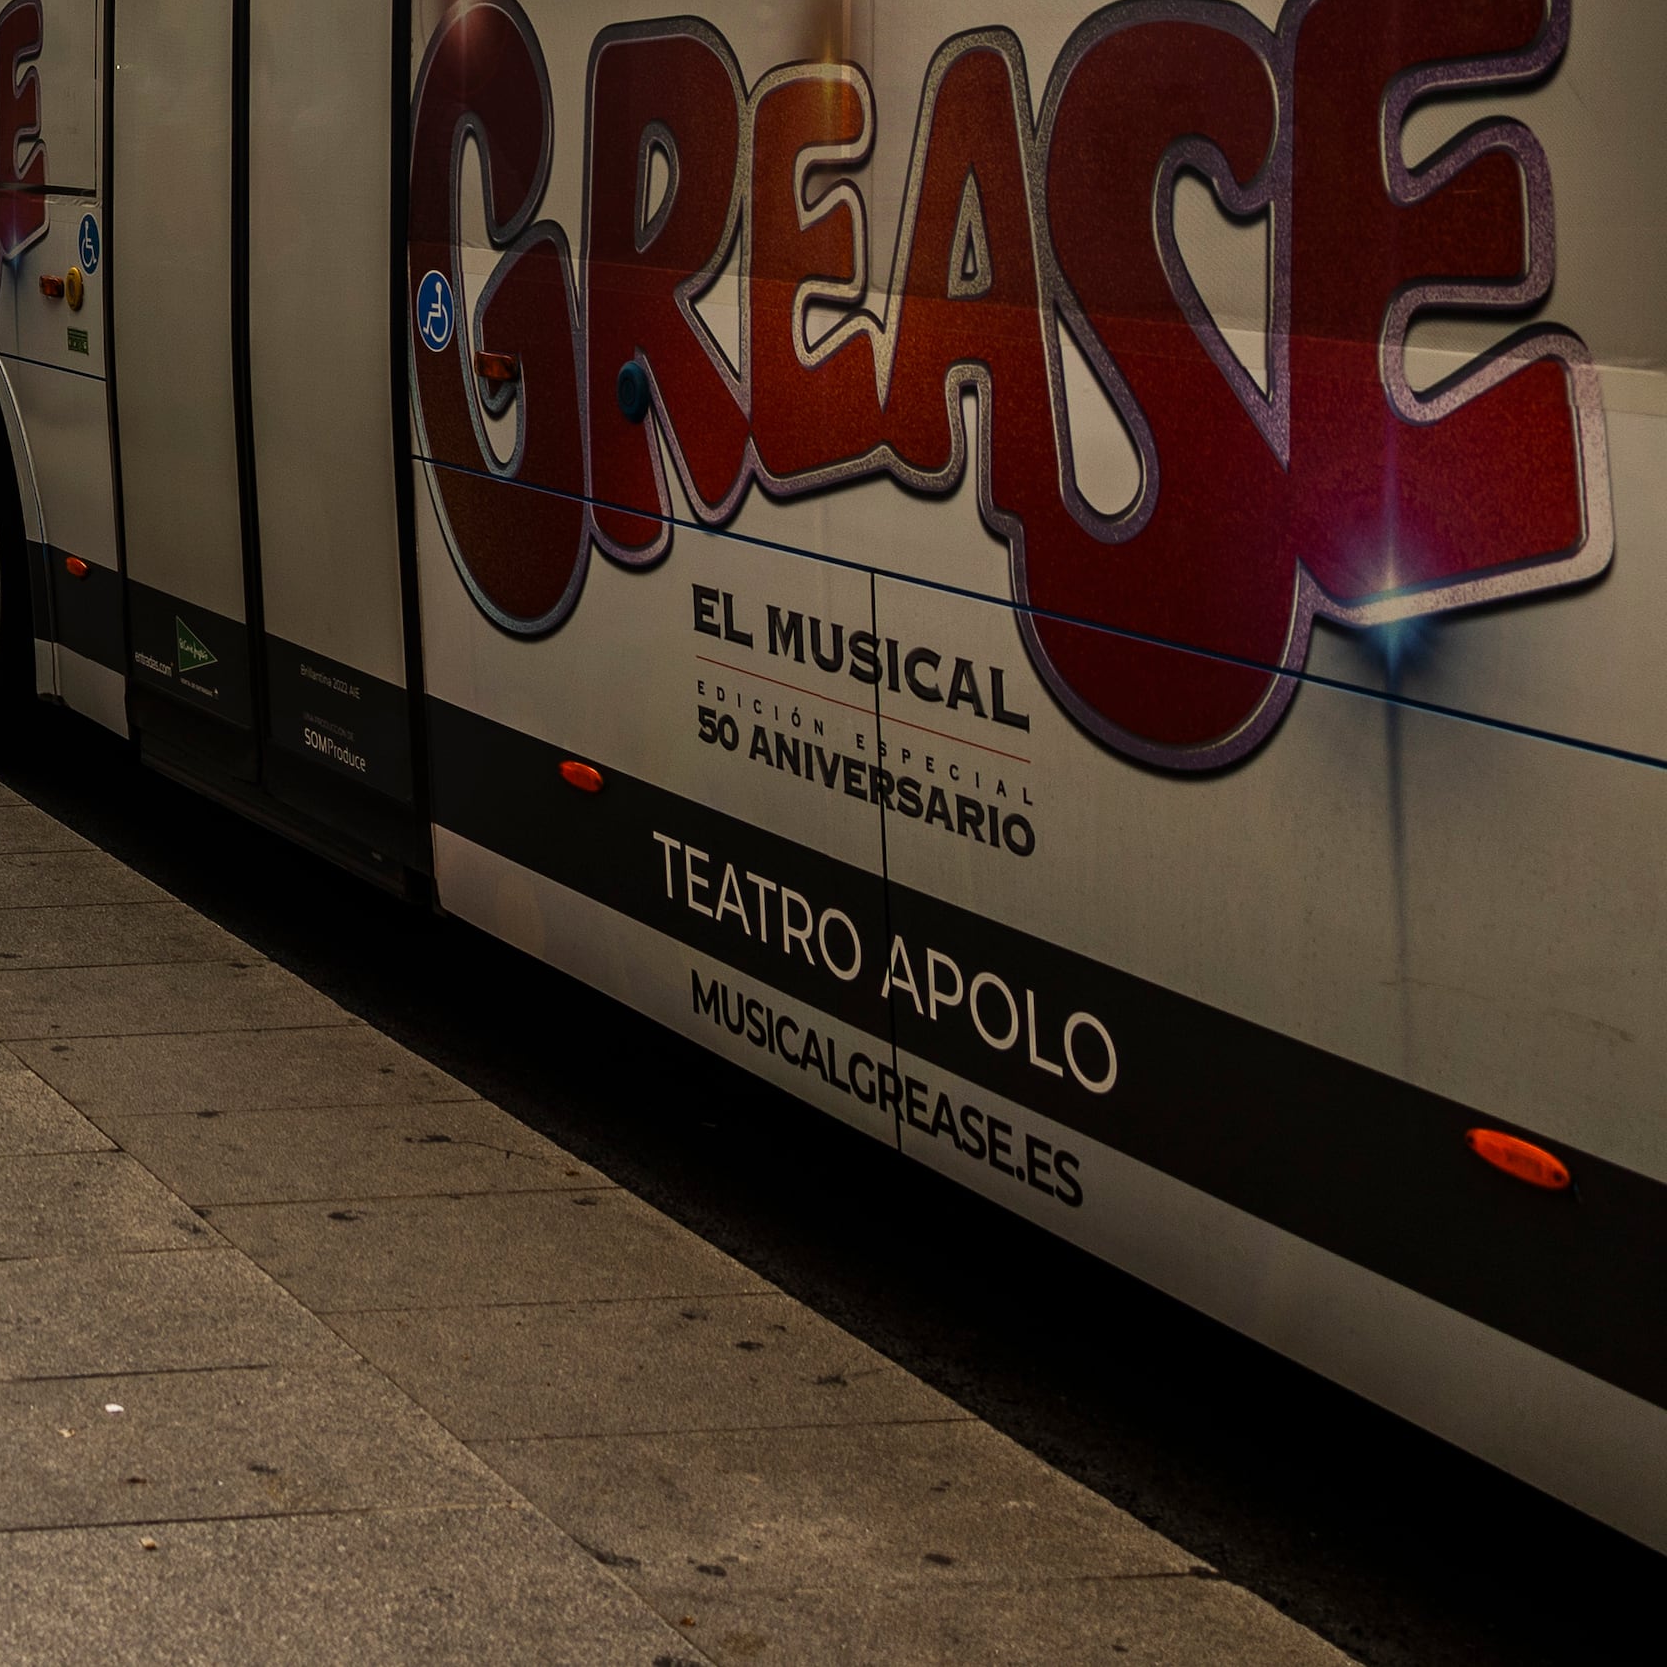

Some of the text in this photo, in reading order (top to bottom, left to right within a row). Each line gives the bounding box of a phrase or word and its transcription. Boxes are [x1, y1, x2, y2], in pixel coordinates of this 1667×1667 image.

[691, 583, 1030, 732] EL MUSICAL
[304, 727, 367, 774] SOMProduce
[697, 680, 1033, 805] EDICIÓN ESPECIAL
[697, 705, 1036, 857] 50 ANIVERSARIO
[652, 830, 1118, 1095] TEATRO APOLO
[691, 969, 1084, 1208] MUSICALGREASE.ES
